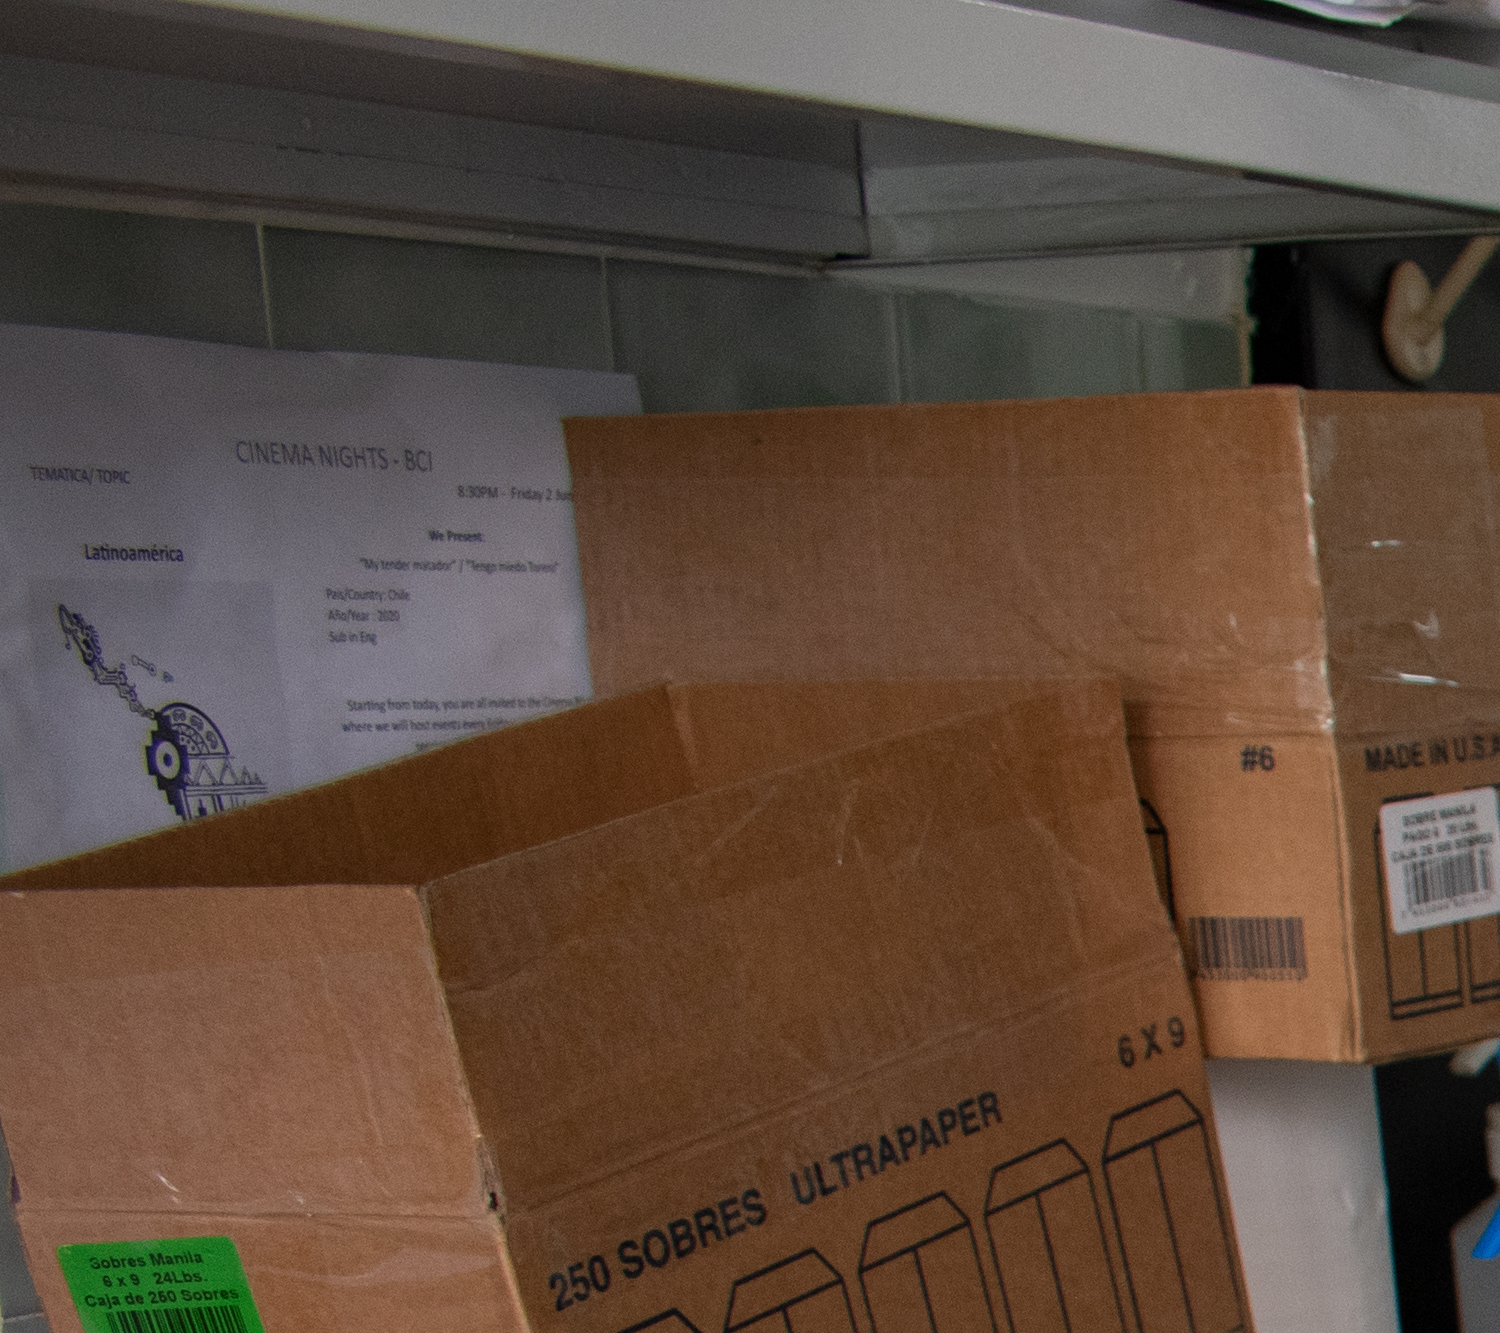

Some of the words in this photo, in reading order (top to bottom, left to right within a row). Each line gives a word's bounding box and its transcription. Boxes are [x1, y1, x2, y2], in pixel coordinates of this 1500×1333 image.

[234, 440, 314, 467] CINEMA
[317, 444, 390, 470] NIGHTS
[404, 448, 434, 473] BCI
[96, 467, 131, 484] TOPIC
[510, 486, 542, 501] Friday
[427, 529, 444, 542] We
[83, 543, 185, 562] Latinoamérica
[328, 630, 346, 644] Sub
[348, 631, 358, 643] in
[359, 631, 377, 646] Eng
[346, 698, 387, 713] Starting
[387, 698, 410, 710] from
[342, 719, 372, 733] where
[374, 721, 390, 732] we
[1240, 744, 1275, 772] #6
[1364, 742, 1425, 772] MADE
[1429, 741, 1448, 765] IN
[1117, 1034, 1135, 1069] 6
[1167, 1015, 1185, 1048] 9
[548, 1254, 611, 1312] 250
[616, 1187, 768, 1280] SOBRES
[788, 1090, 1003, 1206] ULTRAPAPER
[88, 1255, 147, 1271] Sobres
[148, 1251, 204, 1266] Manila
[102, 1274, 113, 1288] 6
[129, 1273, 141, 1287] 9
[84, 1294, 121, 1310] Caja
[124, 1292, 144, 1306] de
[148, 1289, 177, 1304] 250
[180, 1288, 240, 1303] Sobres
